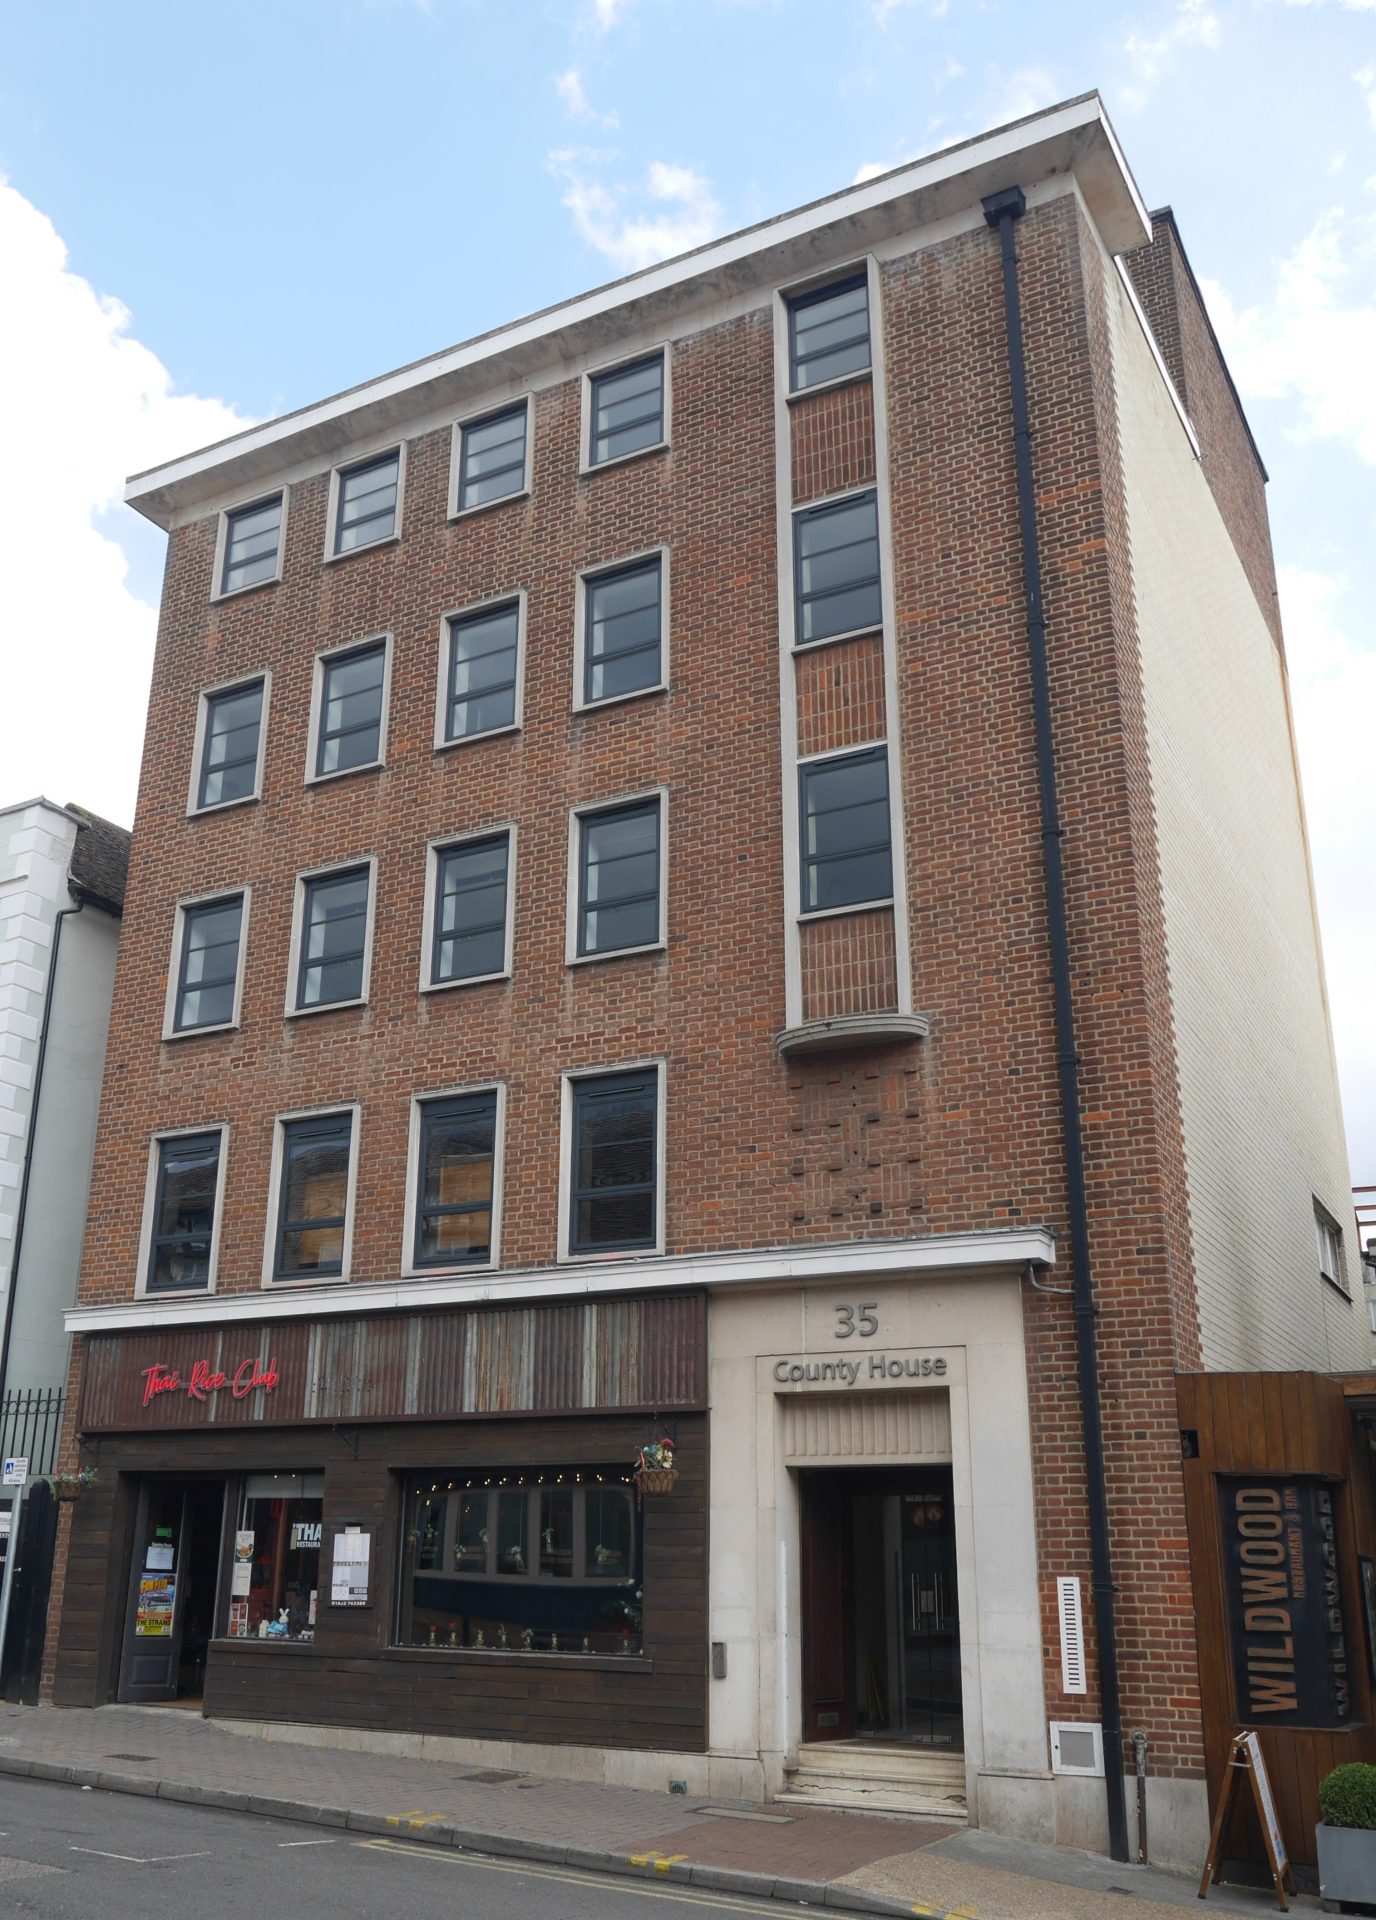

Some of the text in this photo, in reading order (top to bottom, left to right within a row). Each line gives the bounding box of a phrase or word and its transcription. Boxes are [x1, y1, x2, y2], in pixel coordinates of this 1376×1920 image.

[835, 1302, 878, 1338] 35
[141, 1356, 279, 1407] Thai Rice Club
[773, 1355, 947, 1385] County House
[1284, 1487, 1298, 1510] BAR
[1287, 1527, 1304, 1599] RESTAURANT
[1235, 1488, 1298, 1713] WILDWOOD
[1318, 1489, 1349, 1716] WILDWOOD
